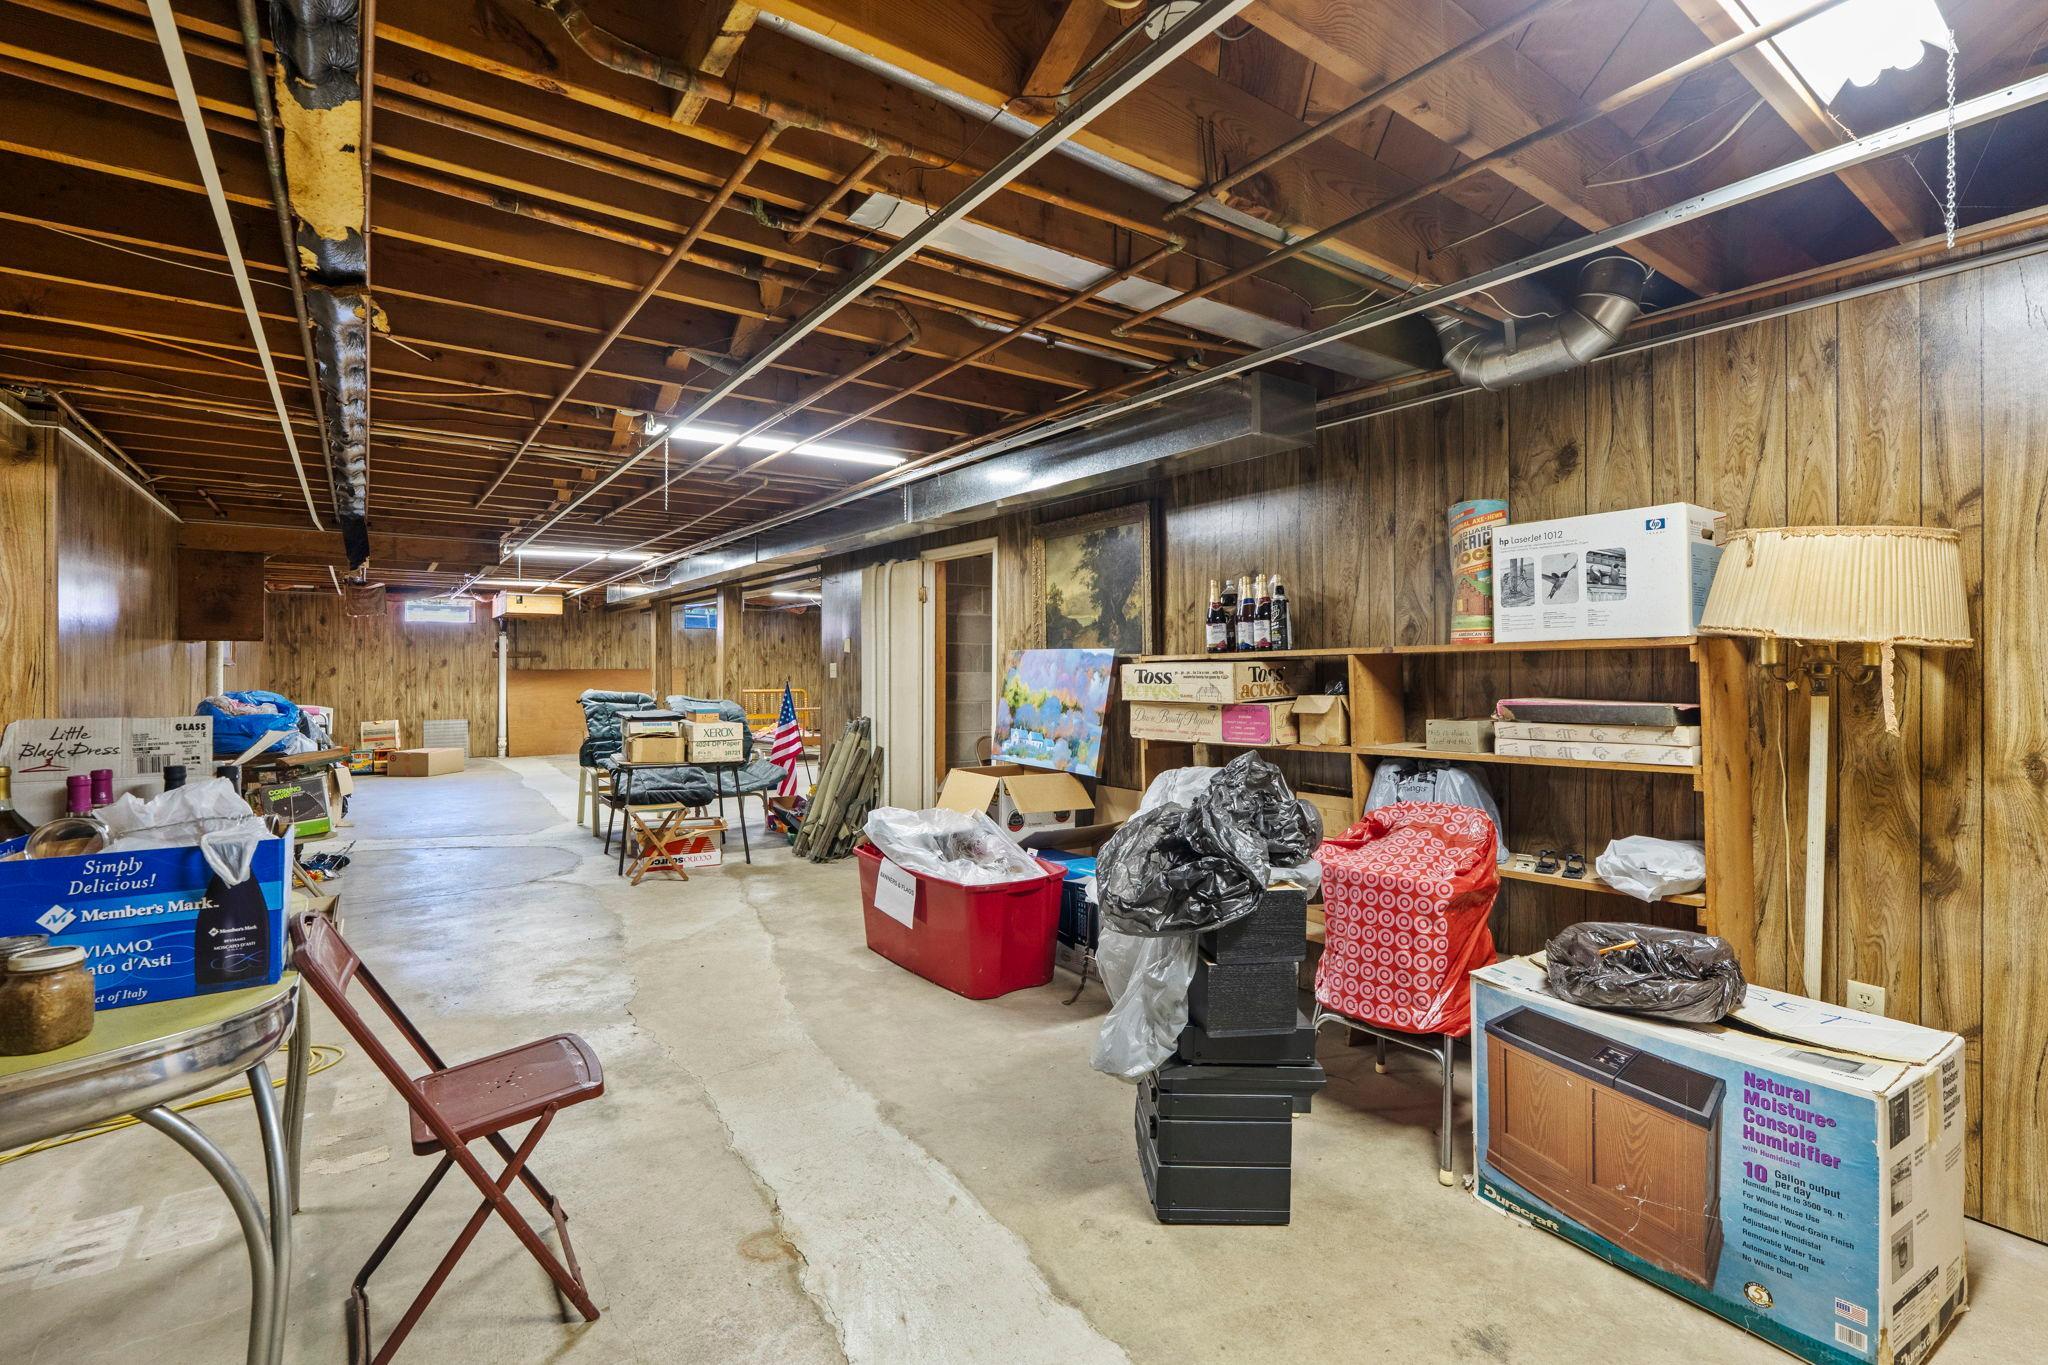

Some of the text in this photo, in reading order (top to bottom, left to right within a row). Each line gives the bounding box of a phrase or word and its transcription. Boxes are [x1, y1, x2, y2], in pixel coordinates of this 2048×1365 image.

[1499, 537, 1509, 546] hp
[1511, 533, 1542, 545] LaserJet
[1543, 530, 1563, 541] 1012
[1134, 668, 1173, 685] Toss
[1248, 666, 1284, 683] Toss
[1125, 683, 1180, 700] across
[1240, 682, 1290, 699] across
[49, 725, 92, 742] Little
[175, 722, 206, 731] GLASS
[703, 727, 734, 738] XEROX
[18, 742, 66, 761] Black
[67, 741, 120, 757] Dress
[722, 740, 741, 748] Paper
[83, 856, 143, 876] Simply
[68, 873, 157, 896] Delicious!
[901, 884, 915, 897] FLAGS
[80, 904, 164, 923] Member's
[121, 953, 172, 972] d'Asti
[108, 990, 122, 1005] of
[122, 988, 149, 1001] Italy
[1743, 1070, 1811, 1105] Natural
[1743, 1106, 1817, 1144] Console
[1743, 1124, 1842, 1170] Humidifier
[1743, 1144, 1801, 1168] with Humidistat
[1743, 1161, 1841, 1200] 10 Gallon output
[1775, 1180, 1811, 1200] per day
[1742, 1177, 1781, 1197] Humidifies
[1782, 1193, 1792, 1202] up
[1793, 1195, 1801, 1204] to
[1802, 1199, 1822, 1212] 3500
[1483, 1183, 1560, 1233] Duracraft
[1742, 1190, 1820, 1224] For Whole House Use
[1742, 1215, 1822, 1252] Adjustable Humidistat
[1784, 1218, 1829, 1241] Wood-Grain
[1830, 1234, 1855, 1250] Finish
[1742, 1228, 1826, 1266] Removable Water Tank
[1742, 1240, 1809, 1273] Automatic Shut-Off
[1742, 1253, 1793, 1280] No White Dust
